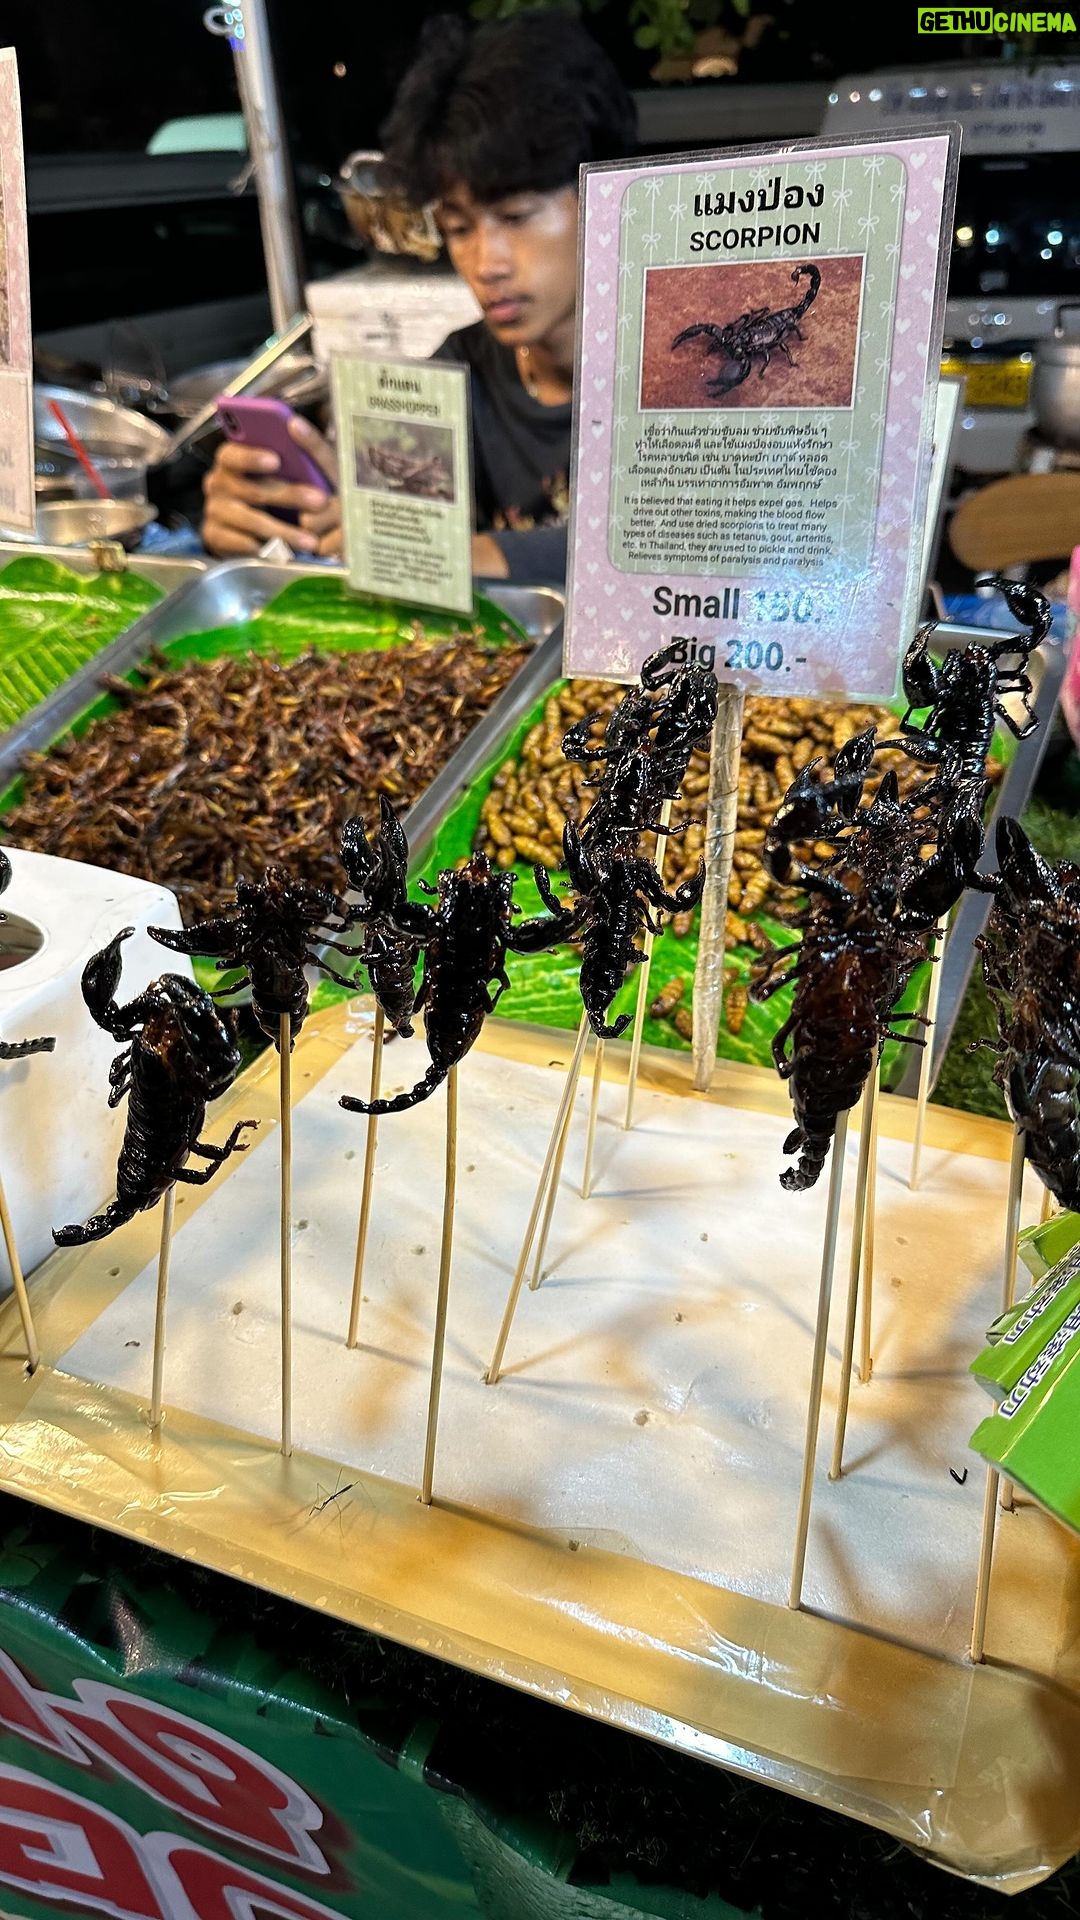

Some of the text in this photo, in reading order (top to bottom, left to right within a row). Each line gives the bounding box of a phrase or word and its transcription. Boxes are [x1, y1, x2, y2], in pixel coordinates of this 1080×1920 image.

[694, 176, 825, 217] แมงป่อง
[689, 222, 821, 252] SCORPION
[640, 496, 675, 505] believed
[677, 497, 694, 506] that
[695, 497, 723, 508] eating
[732, 498, 756, 508] helps
[758, 498, 783, 508] expel
[810, 499, 838, 510] Helps
[633, 508, 826, 519] drive out other toxins, making the blood flow
[630, 518, 827, 533] better. And use dried scorpions to treat many
[623, 529, 646, 539] types
[646, 529, 656, 538] of
[657, 530, 695, 539] diseases
[696, 531, 719, 540] such
[732, 532, 768, 542] tetanus,
[770, 533, 793, 543] gout,
[795, 535, 834, 544] arteritis,
[622, 541, 638, 549] etc.
[649, 541, 687, 551] Thailand,
[688, 542, 707, 553] they
[707, 544, 722, 552] are
[723, 543, 745, 552] used
[747, 544, 757, 553] to
[758, 544, 786, 554] pickle
[787, 545, 806, 554] and
[628, 551, 824, 568] Relieves symptoms of paralysis and paralysis
[653, 586, 740, 620] Small
[670, 636, 807, 673] Big 200.-
